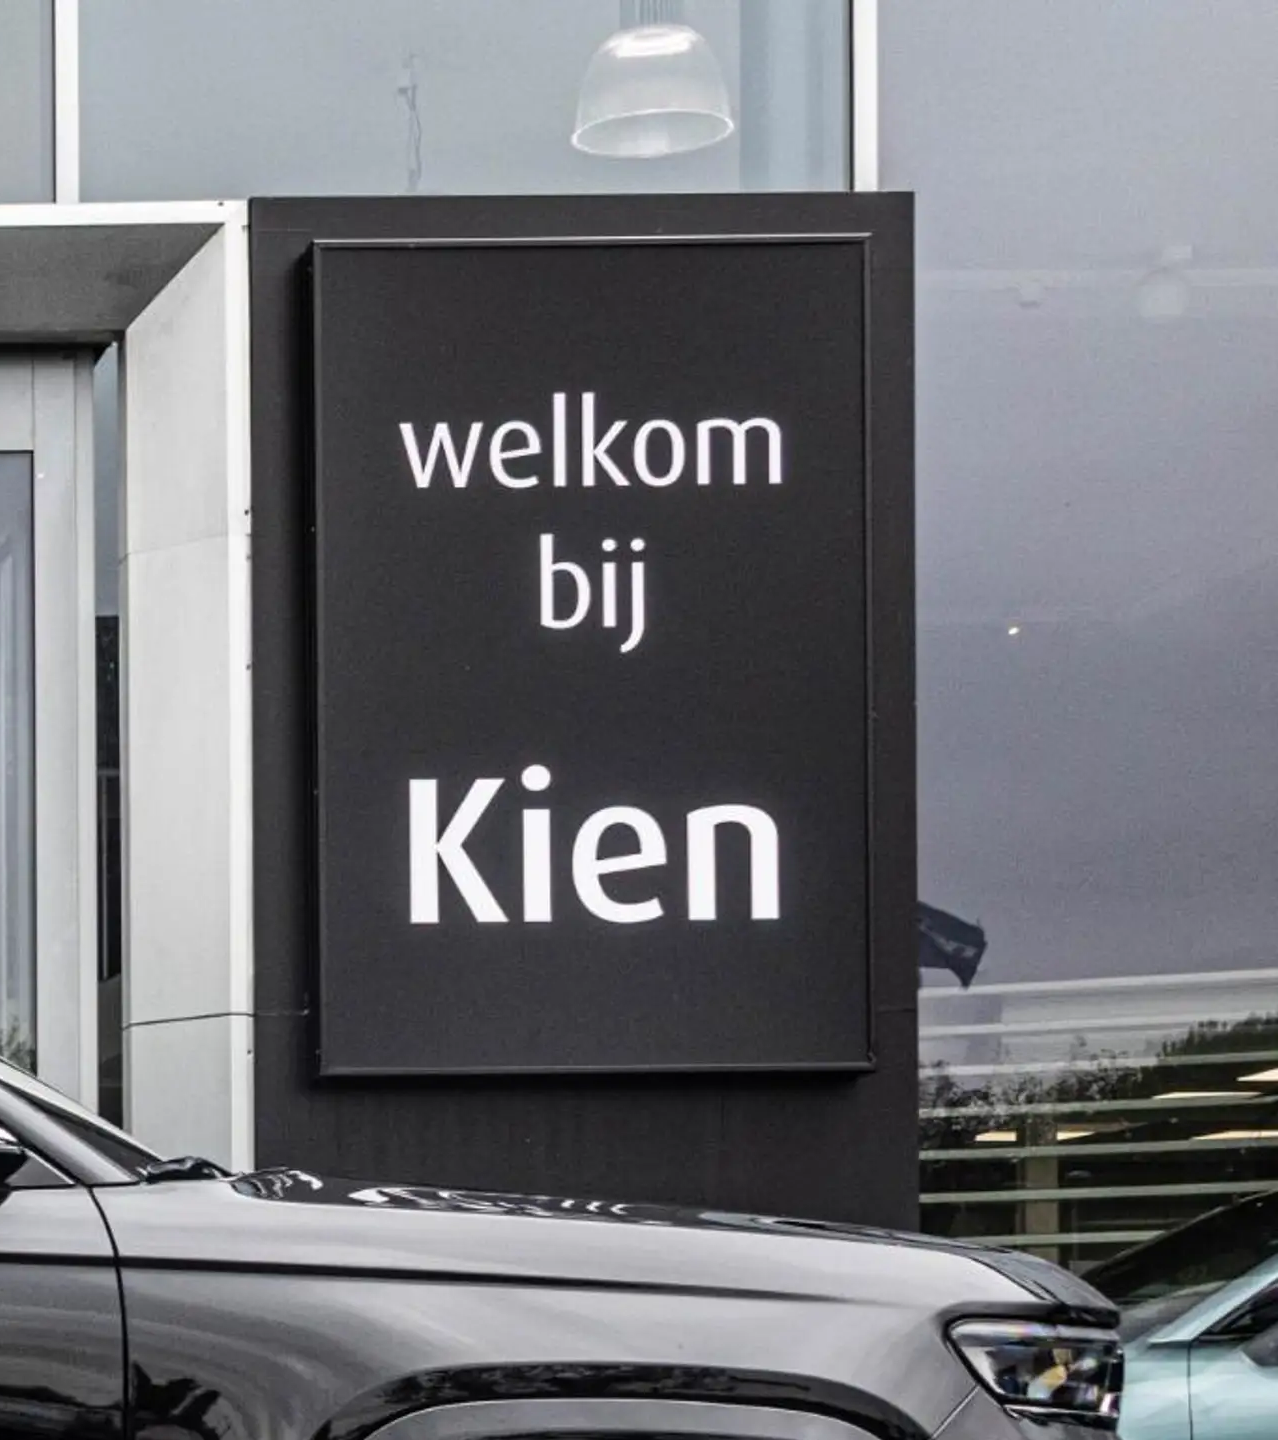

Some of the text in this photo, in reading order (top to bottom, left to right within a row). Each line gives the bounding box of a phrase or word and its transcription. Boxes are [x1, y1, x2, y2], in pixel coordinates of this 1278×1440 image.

[399, 391, 782, 488] welkom
[539, 533, 646, 653] bij
[408, 763, 780, 924] Kien
